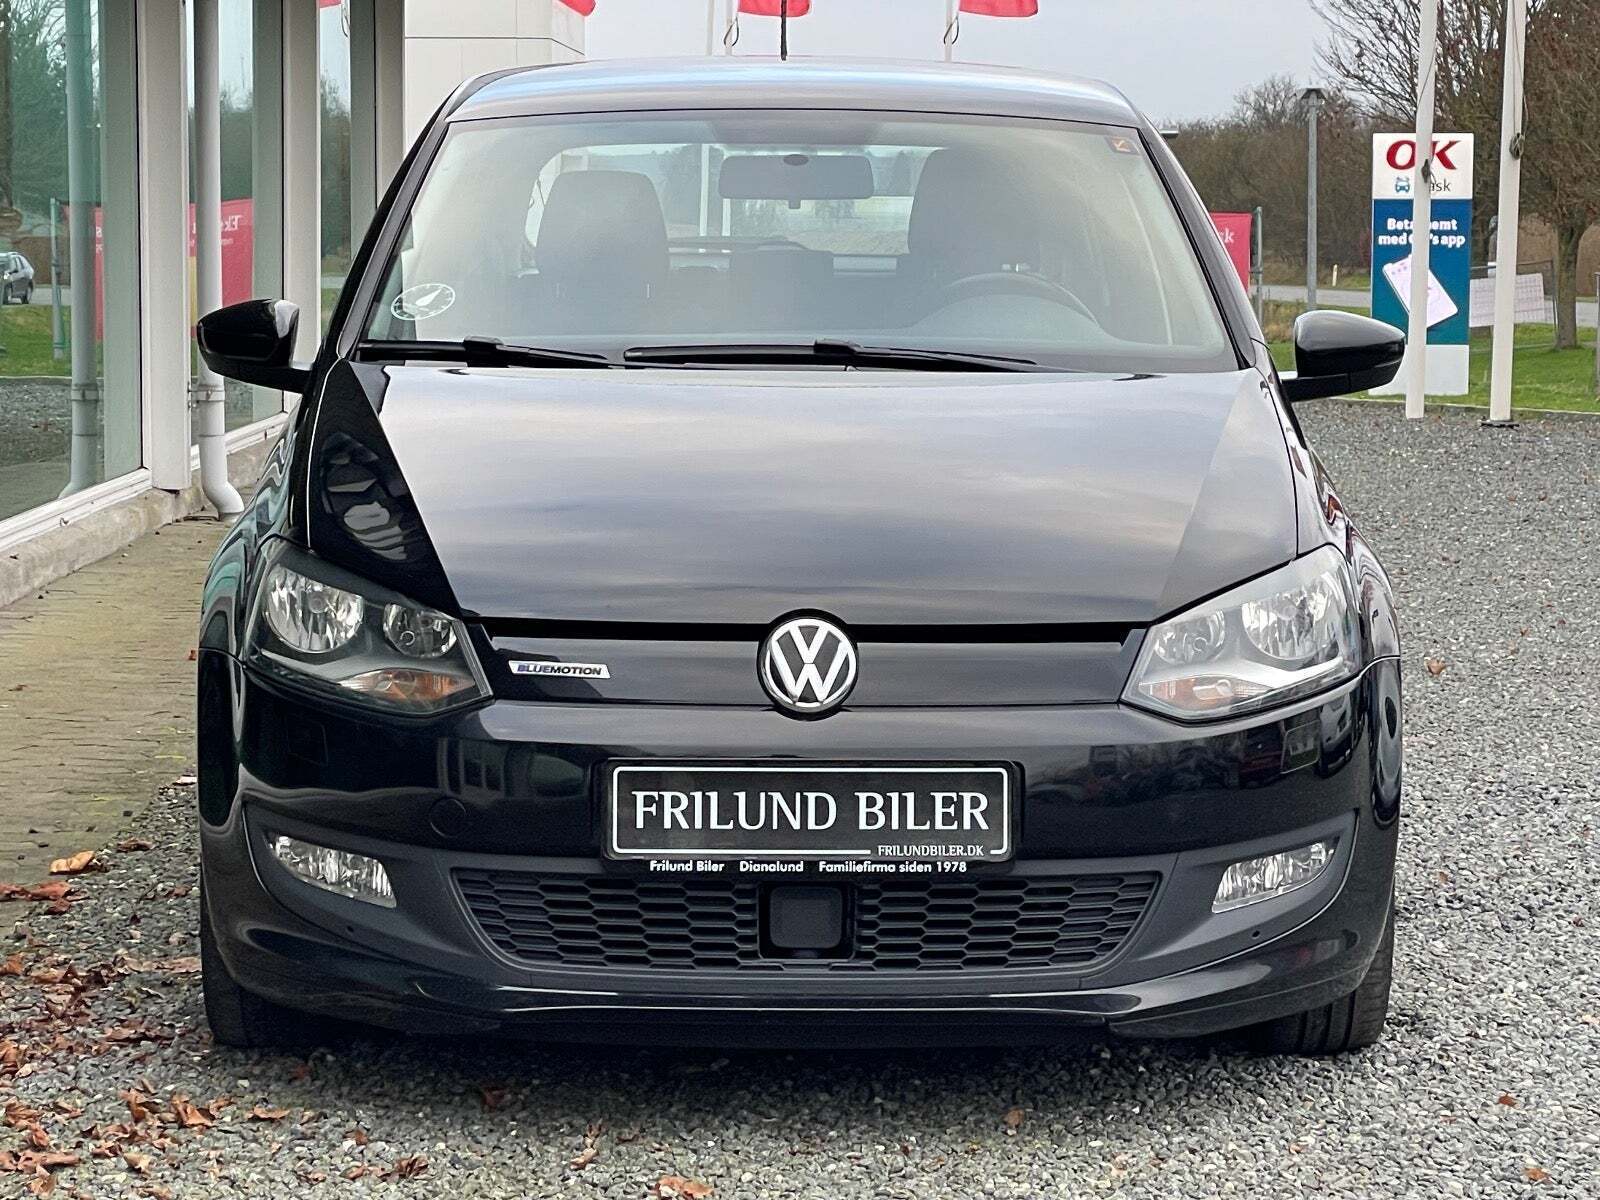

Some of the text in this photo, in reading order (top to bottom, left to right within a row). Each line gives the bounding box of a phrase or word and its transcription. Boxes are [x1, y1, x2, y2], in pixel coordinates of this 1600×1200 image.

[1386, 140, 1461, 170] OK
[1429, 219, 1458, 230] emt
[1378, 232, 1407, 245] med
[1440, 234, 1466, 248] app
[516, 663, 602, 676] BLUEMOTION
[631, 790, 989, 831] FRILUND BILER
[877, 844, 984, 857] FRILUNDBILER.DK
[649, 859, 967, 873] Frilund Biler Dianalund Familiefirma siden 1978
